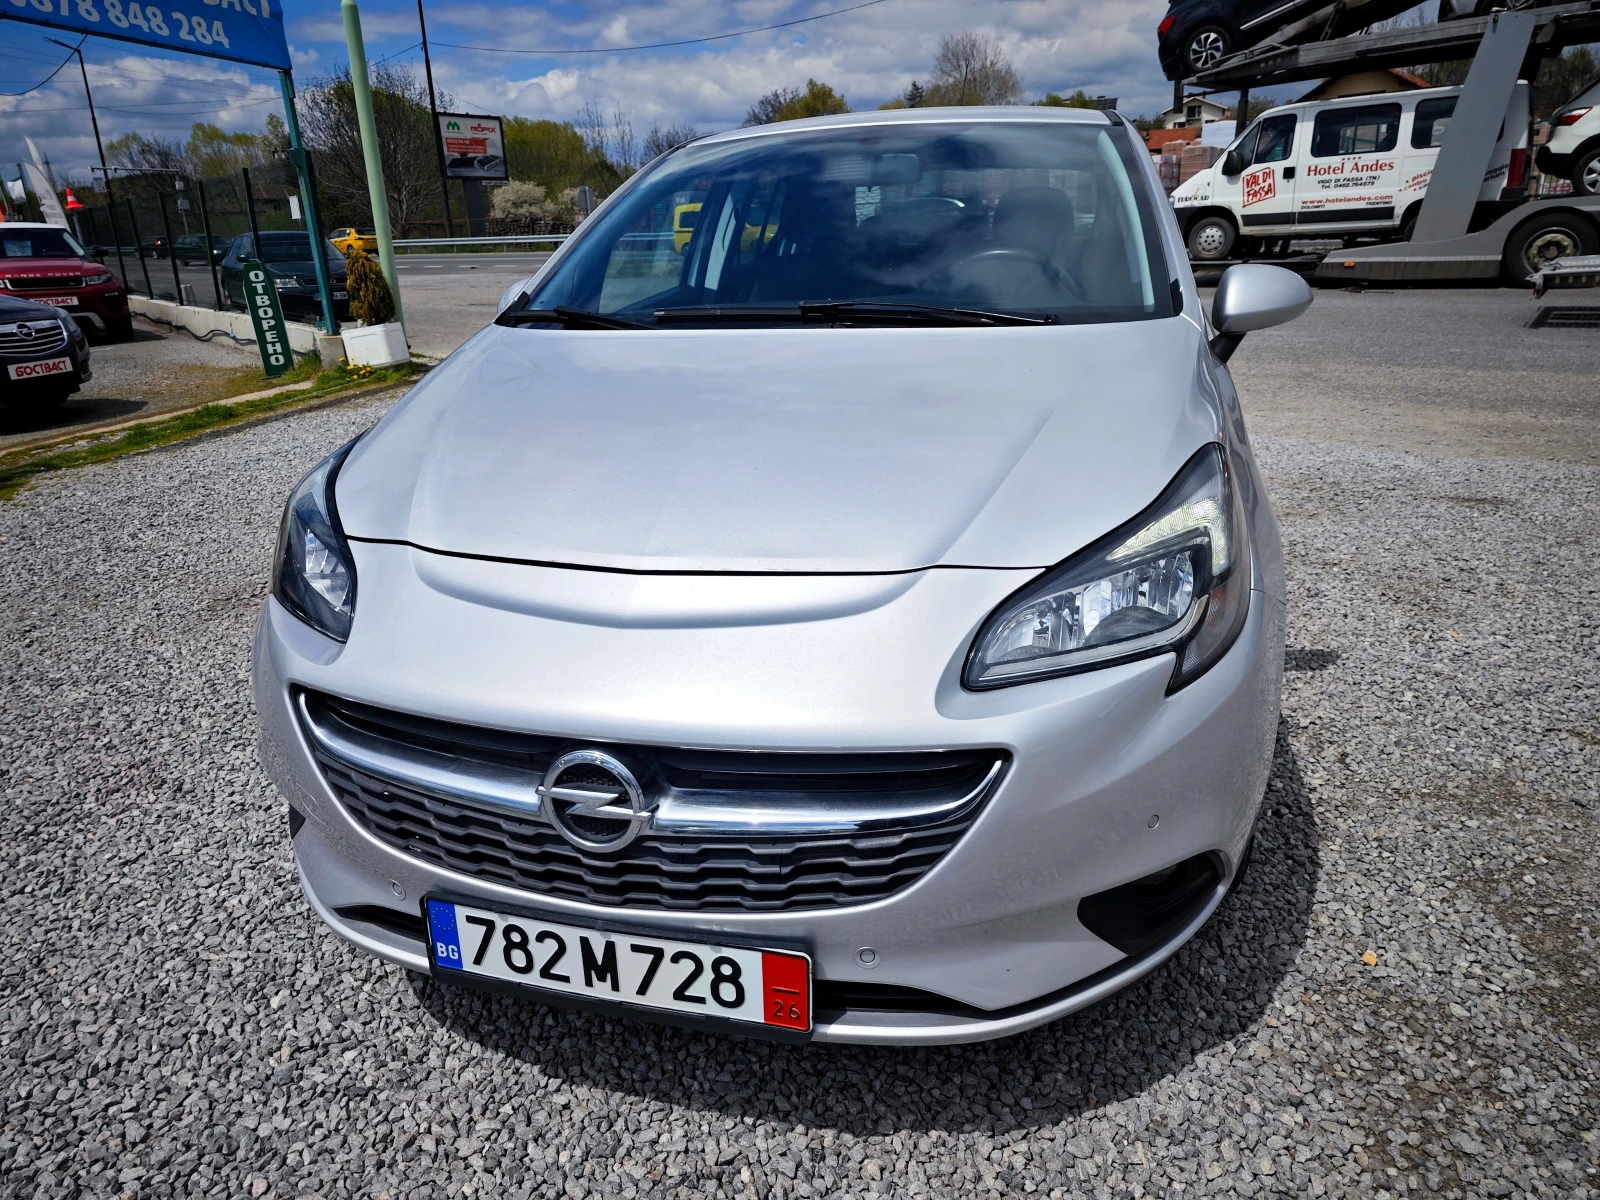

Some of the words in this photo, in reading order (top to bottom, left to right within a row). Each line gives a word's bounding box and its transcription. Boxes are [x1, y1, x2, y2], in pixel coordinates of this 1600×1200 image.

[103, 0, 170, 36] 848
[171, 11, 230, 49] 284
[1307, 162, 1345, 176] Hotel
[1350, 160, 1395, 173] Andes
[1485, 163, 1509, 176] aggio
[1245, 174, 1260, 188] VAL
[1262, 170, 1271, 183] DI
[1403, 179, 1427, 191] centro
[1246, 183, 1273, 202] FASSA
[1301, 195, 1393, 205] www.hotelandes.com
[249, 270, 285, 366] ОТВОРЕНО
[436, 942, 459, 960] BG
[772, 999, 801, 1021] 26
